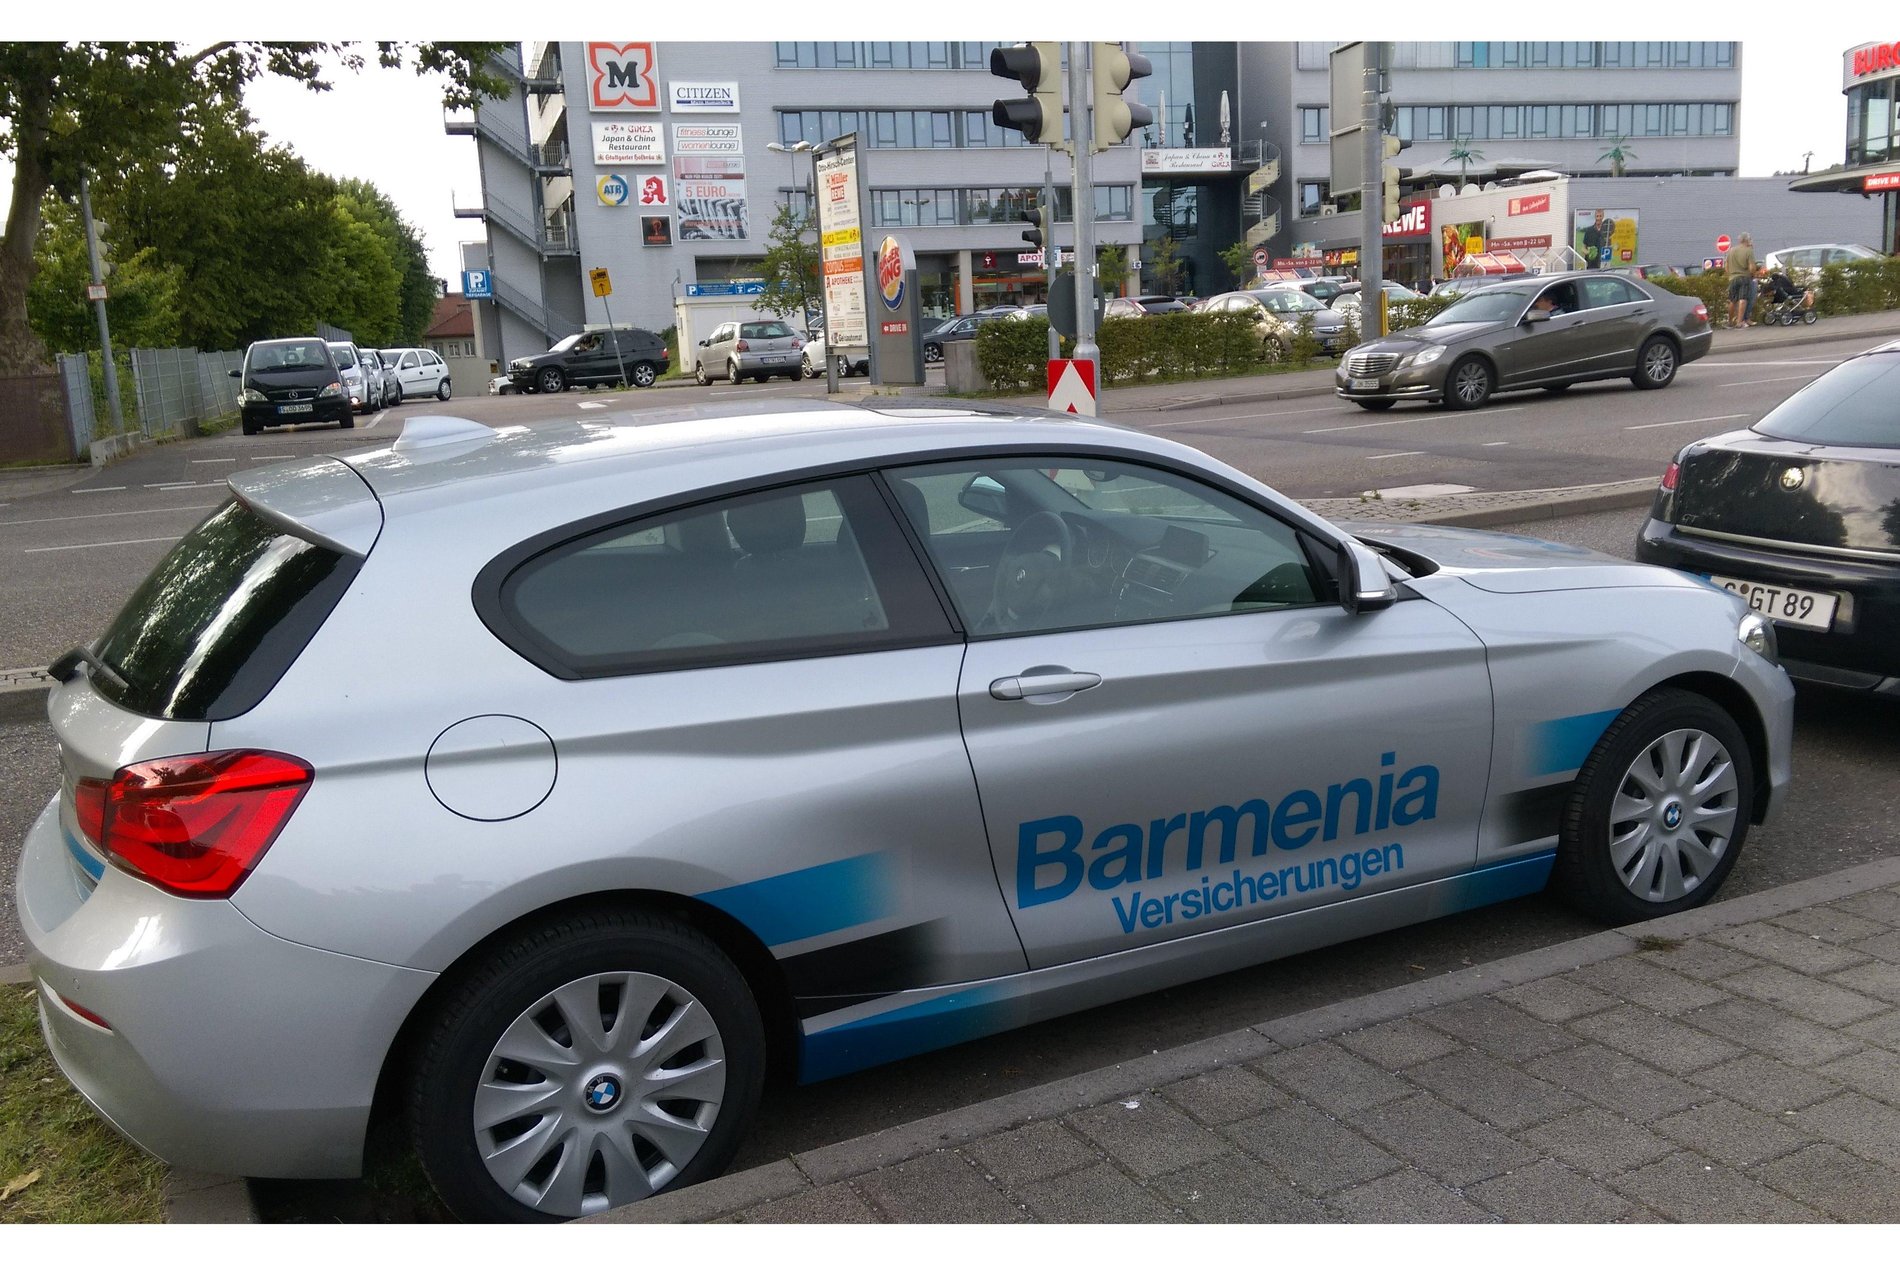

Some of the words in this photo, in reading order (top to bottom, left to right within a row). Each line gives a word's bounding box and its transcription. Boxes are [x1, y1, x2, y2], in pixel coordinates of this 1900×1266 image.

[606, 61, 640, 88] M
[677, 87, 730, 99] CITIZEN
[602, 135, 625, 143] Japan
[608, 143, 651, 151] Restaurant
[1868, 176, 1889, 186] DRIVE
[1891, 175, 1899, 184] IN
[604, 184, 622, 194] ATR
[686, 186, 693, 198] 5
[697, 185, 726, 198] EURO
[880, 258, 901, 289] KING
[1749, 587, 1781, 613] GT
[1783, 592, 1815, 620] 89
[1017, 752, 1440, 909] Barmenia
[1112, 843, 1404, 934] Versicherungen
